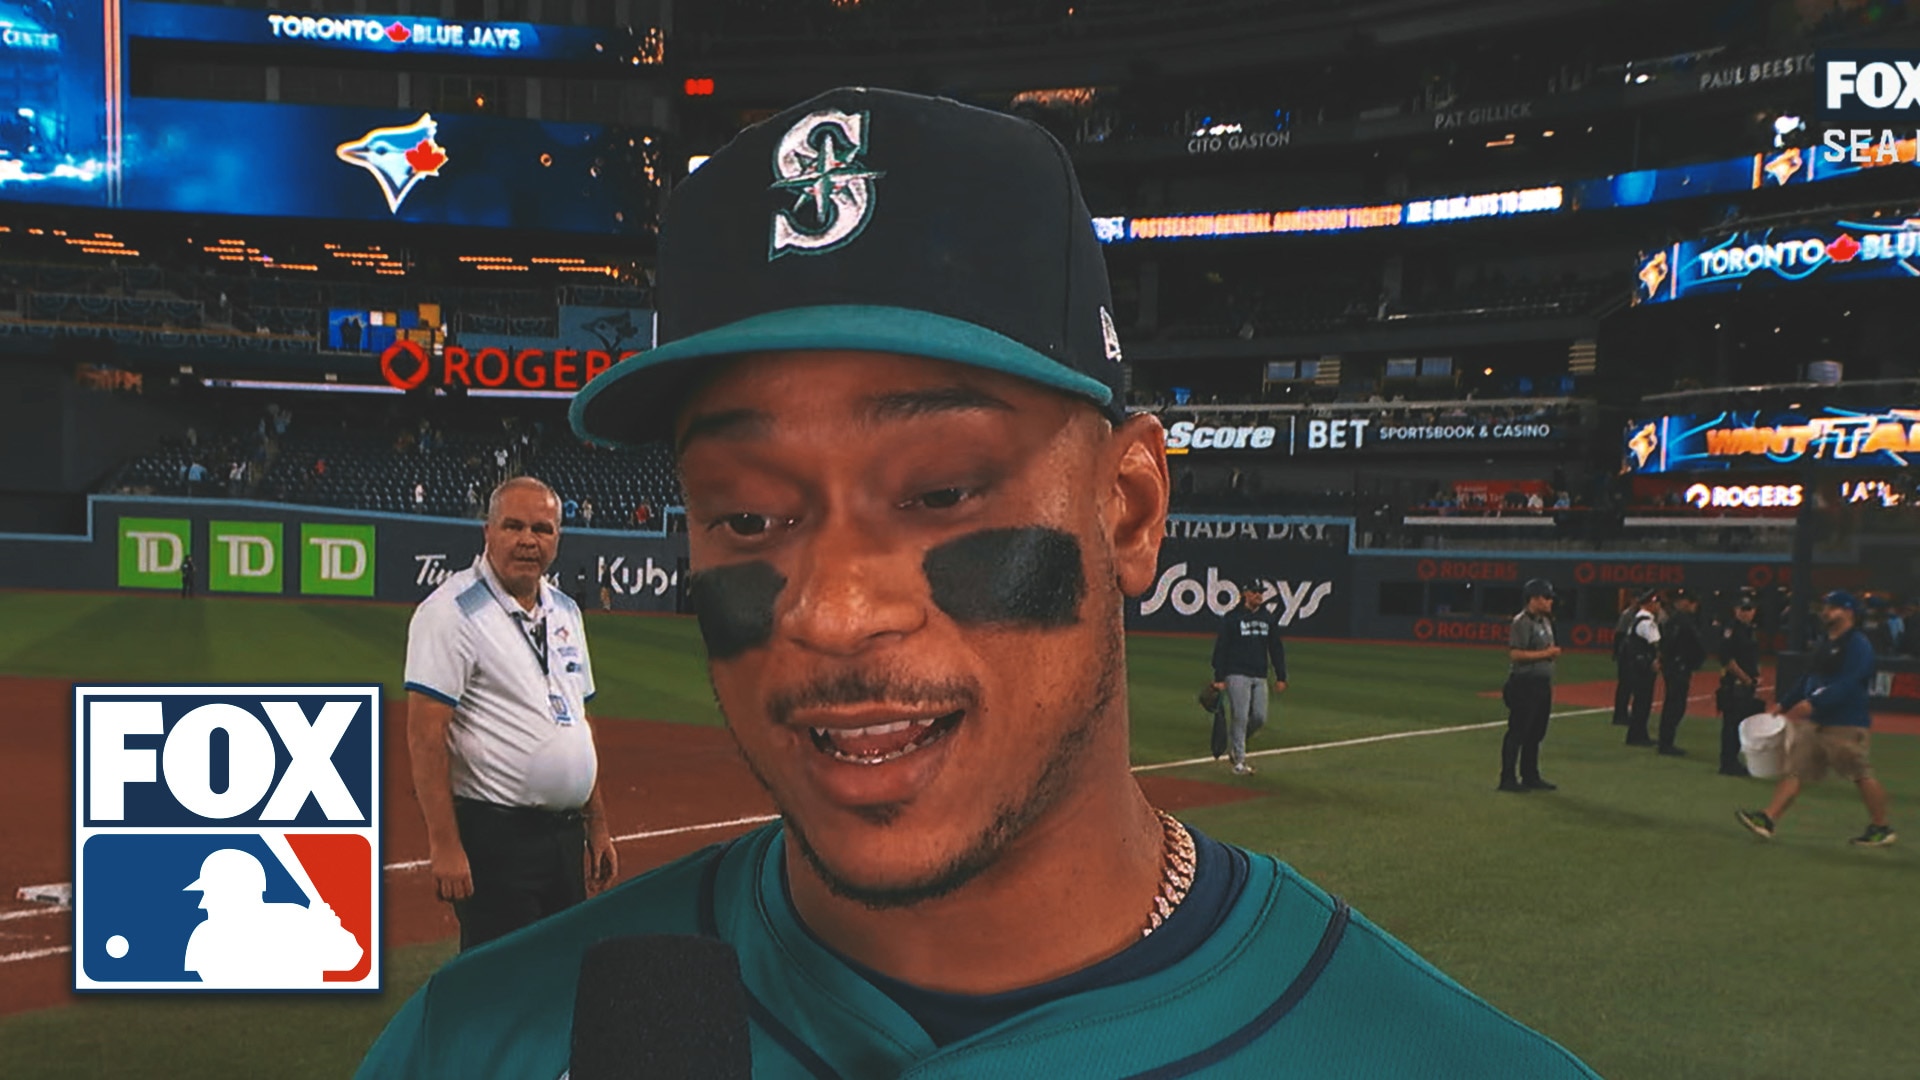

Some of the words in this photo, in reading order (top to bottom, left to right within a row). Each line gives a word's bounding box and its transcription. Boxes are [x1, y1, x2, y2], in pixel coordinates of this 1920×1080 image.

[268, 14, 384, 41] TORONTO
[412, 23, 463, 46] BLUE
[468, 27, 521, 49] JAYS
[1699, 66, 1746, 89] PAUL
[1434, 111, 1464, 129] PAT
[1188, 137, 1222, 153] CITO
[1228, 130, 1290, 150] GASTON
[1700, 238, 1825, 277] TORONTO
[1861, 232, 1920, 261] BLU
[444, 346, 643, 388] ROGER
[1163, 421, 1276, 449] Score
[1308, 419, 1369, 449] BET
[1379, 425, 1476, 440] SPORTSBOOK
[1479, 425, 1489, 439] &
[1493, 424, 1550, 438] CASINO
[1712, 485, 1802, 507] ROGERS
[126, 531, 183, 573] TD
[217, 535, 274, 576] TD
[309, 537, 367, 580] TD
[598, 555, 677, 596] Kub
[1440, 561, 1518, 580] ROGERS
[1601, 564, 1684, 584] ROGERS
